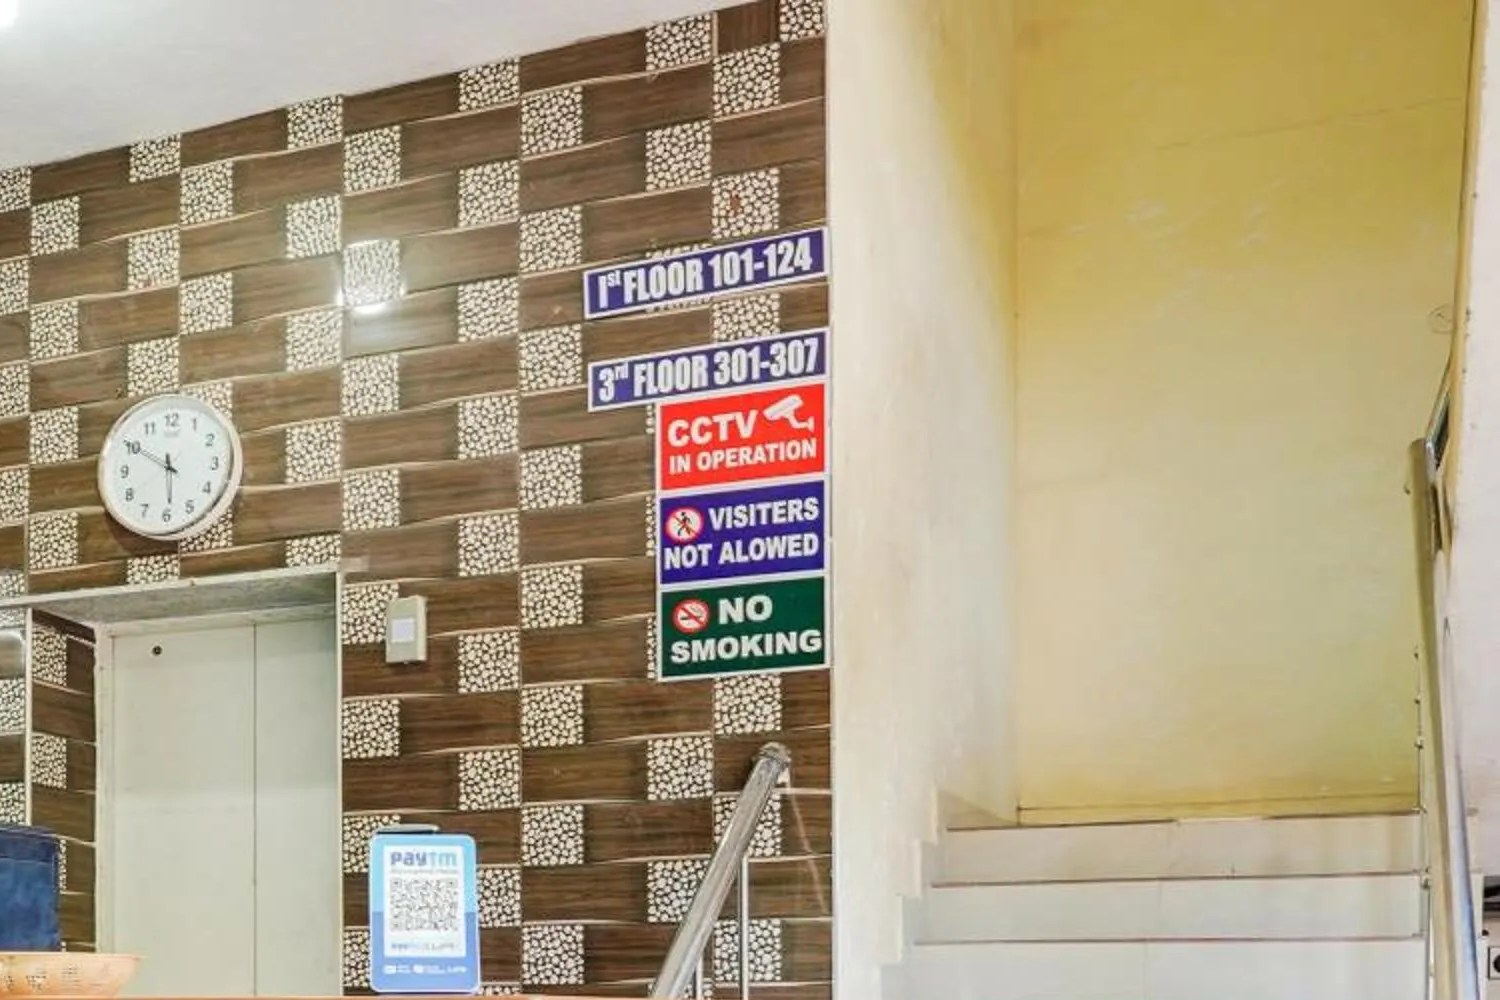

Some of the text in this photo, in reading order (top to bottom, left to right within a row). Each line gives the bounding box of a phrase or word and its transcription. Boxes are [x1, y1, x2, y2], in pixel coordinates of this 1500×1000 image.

[623, 257, 702, 305] FLOOR
[708, 236, 812, 289] 101-124
[599, 337, 819, 403] 3rd FLOOR 301-307
[165, 412, 179, 427] 12
[144, 422, 156, 435] 11
[668, 409, 758, 447] CCTV
[205, 434, 215, 447] 2
[211, 456, 219, 471] 3
[669, 438, 817, 475] IN OPERATION
[120, 465, 129, 479] 9
[125, 488, 134, 501] 8
[202, 481, 211, 494] 4
[140, 503, 149, 518] 7
[162, 508, 171, 522] 6
[185, 500, 195, 515] 5
[708, 497, 820, 531] VISITERS
[664, 531, 819, 570] NOT ALOWED
[718, 595, 773, 625] NO
[670, 629, 822, 664] SMOKING
